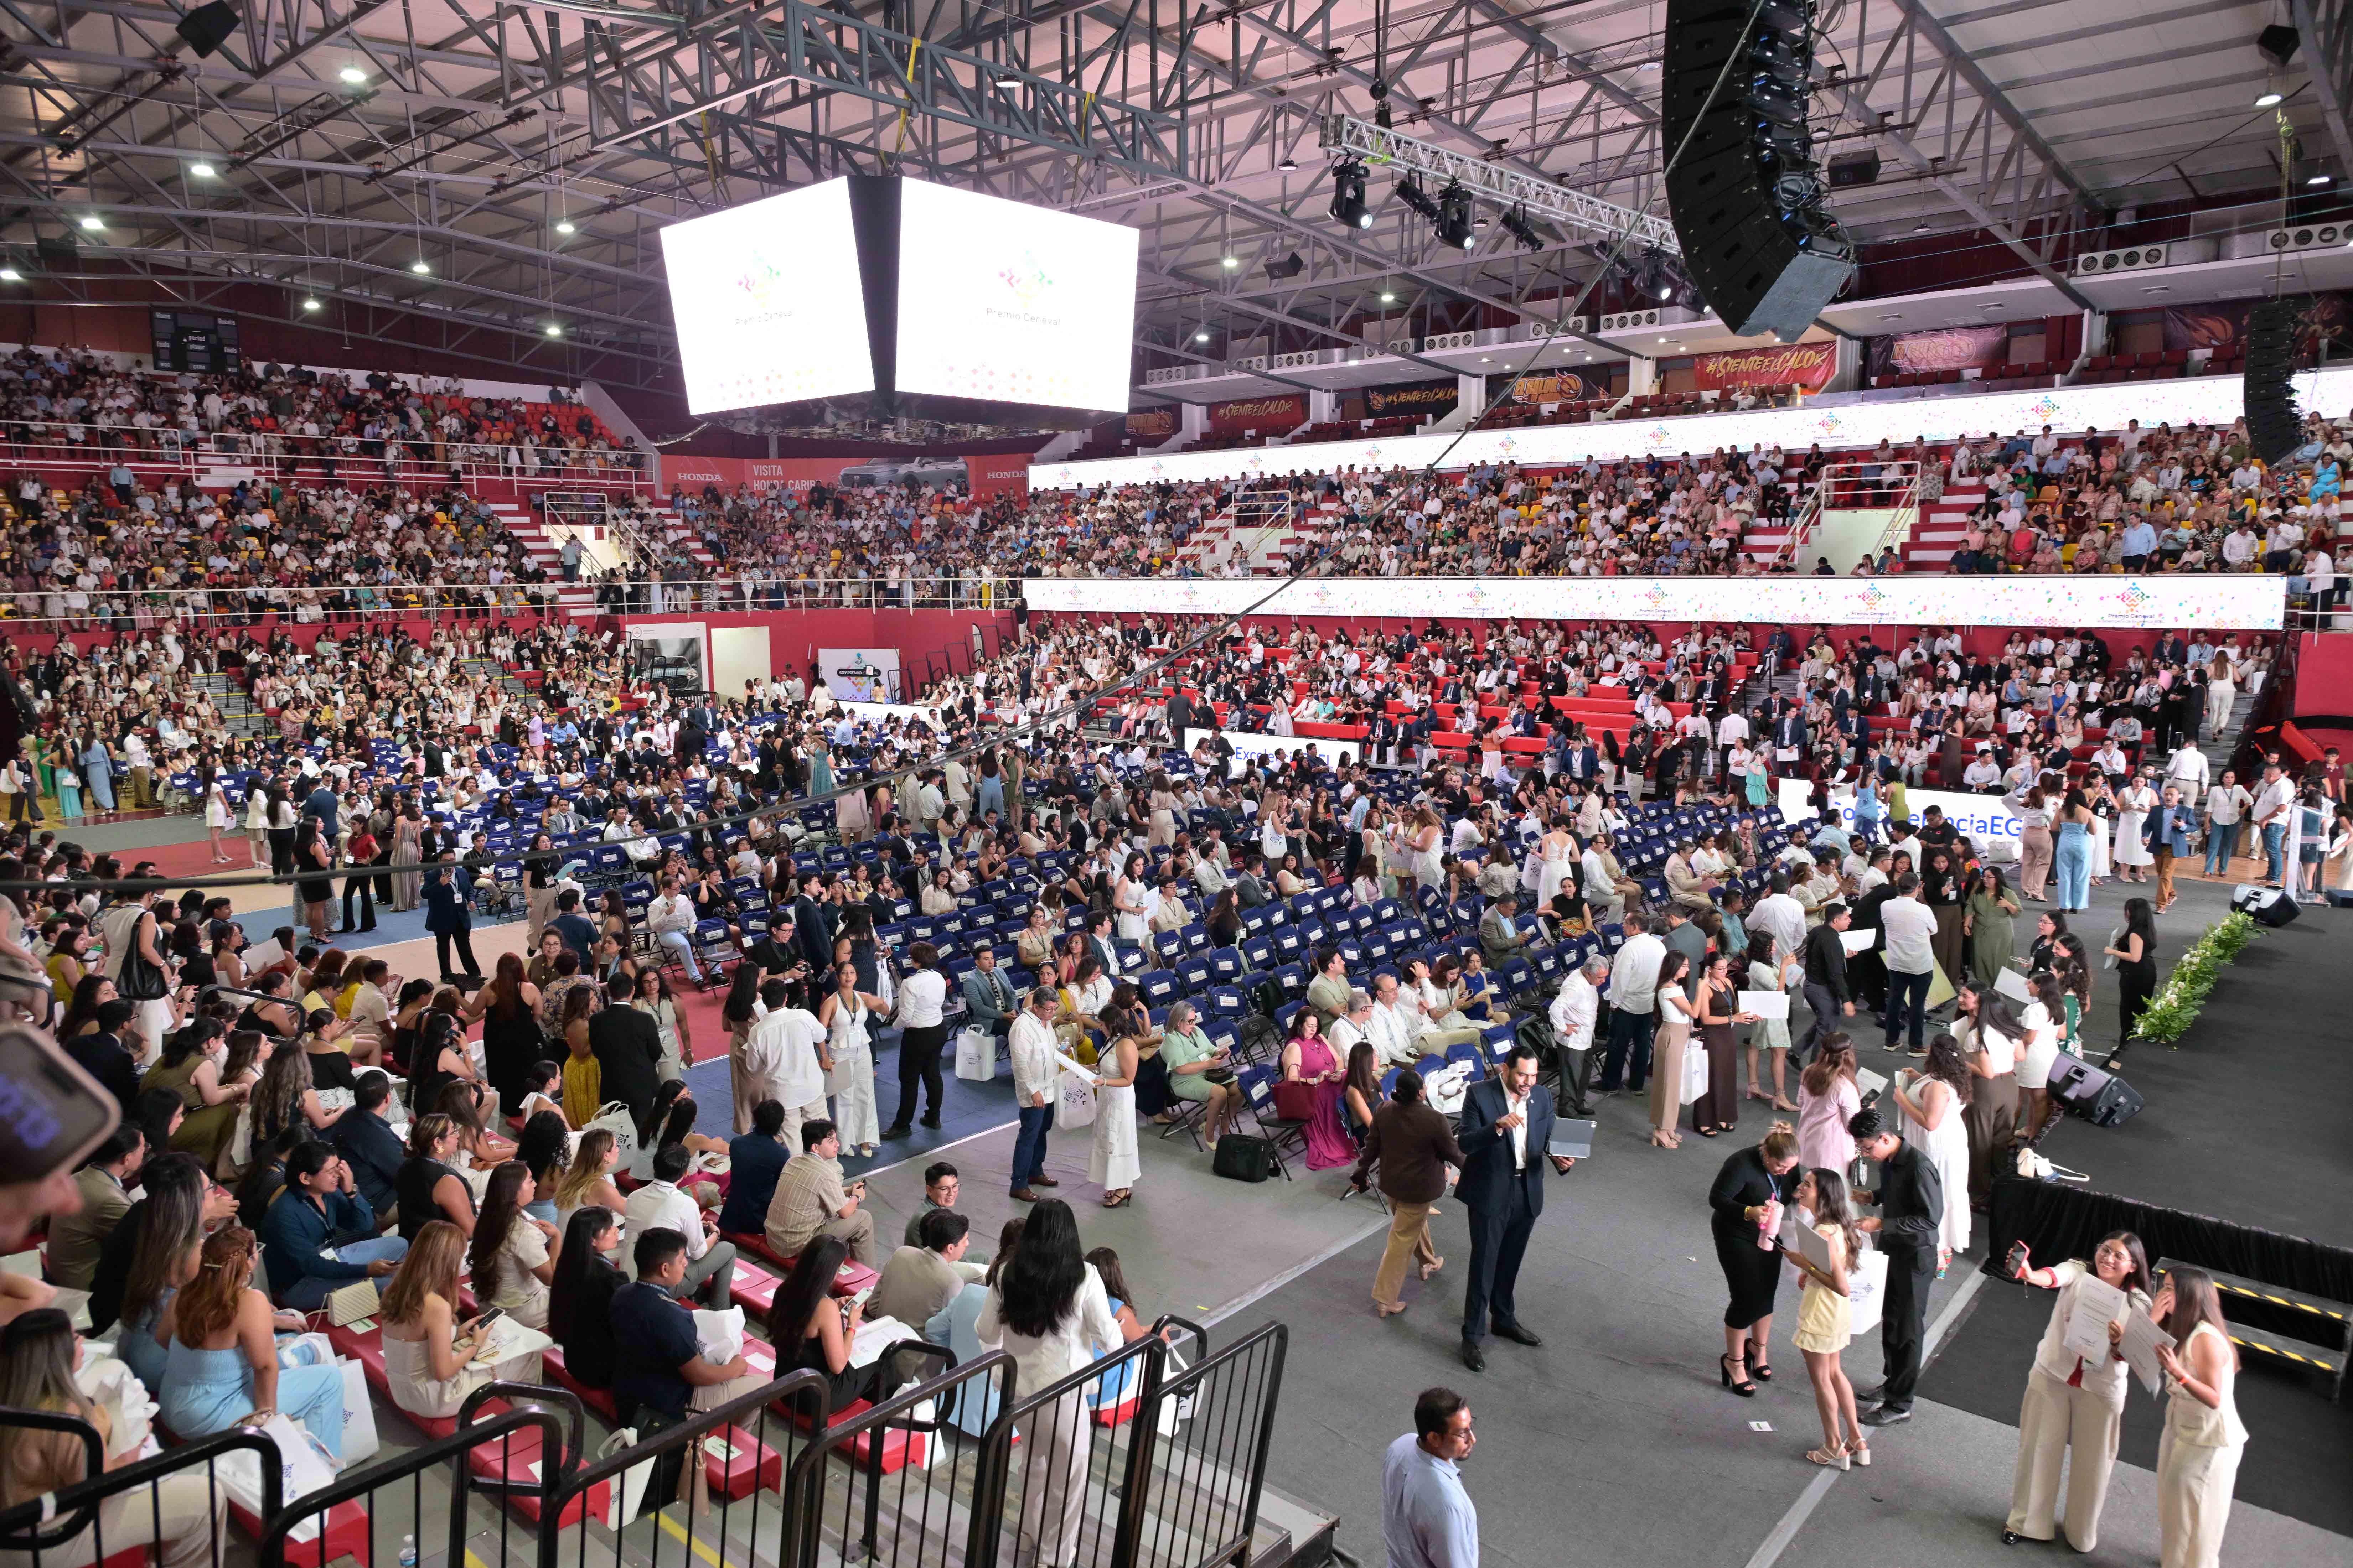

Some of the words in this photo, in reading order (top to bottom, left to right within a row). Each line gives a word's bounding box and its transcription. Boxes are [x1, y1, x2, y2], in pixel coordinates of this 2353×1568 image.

[986, 307, 1020, 320] Premio
[1023, 313, 1060, 325] Ceneval
[753, 465, 783, 476] VISITA
[987, 471, 1026, 479] HONDA
[677, 473, 723, 482] HONDA
